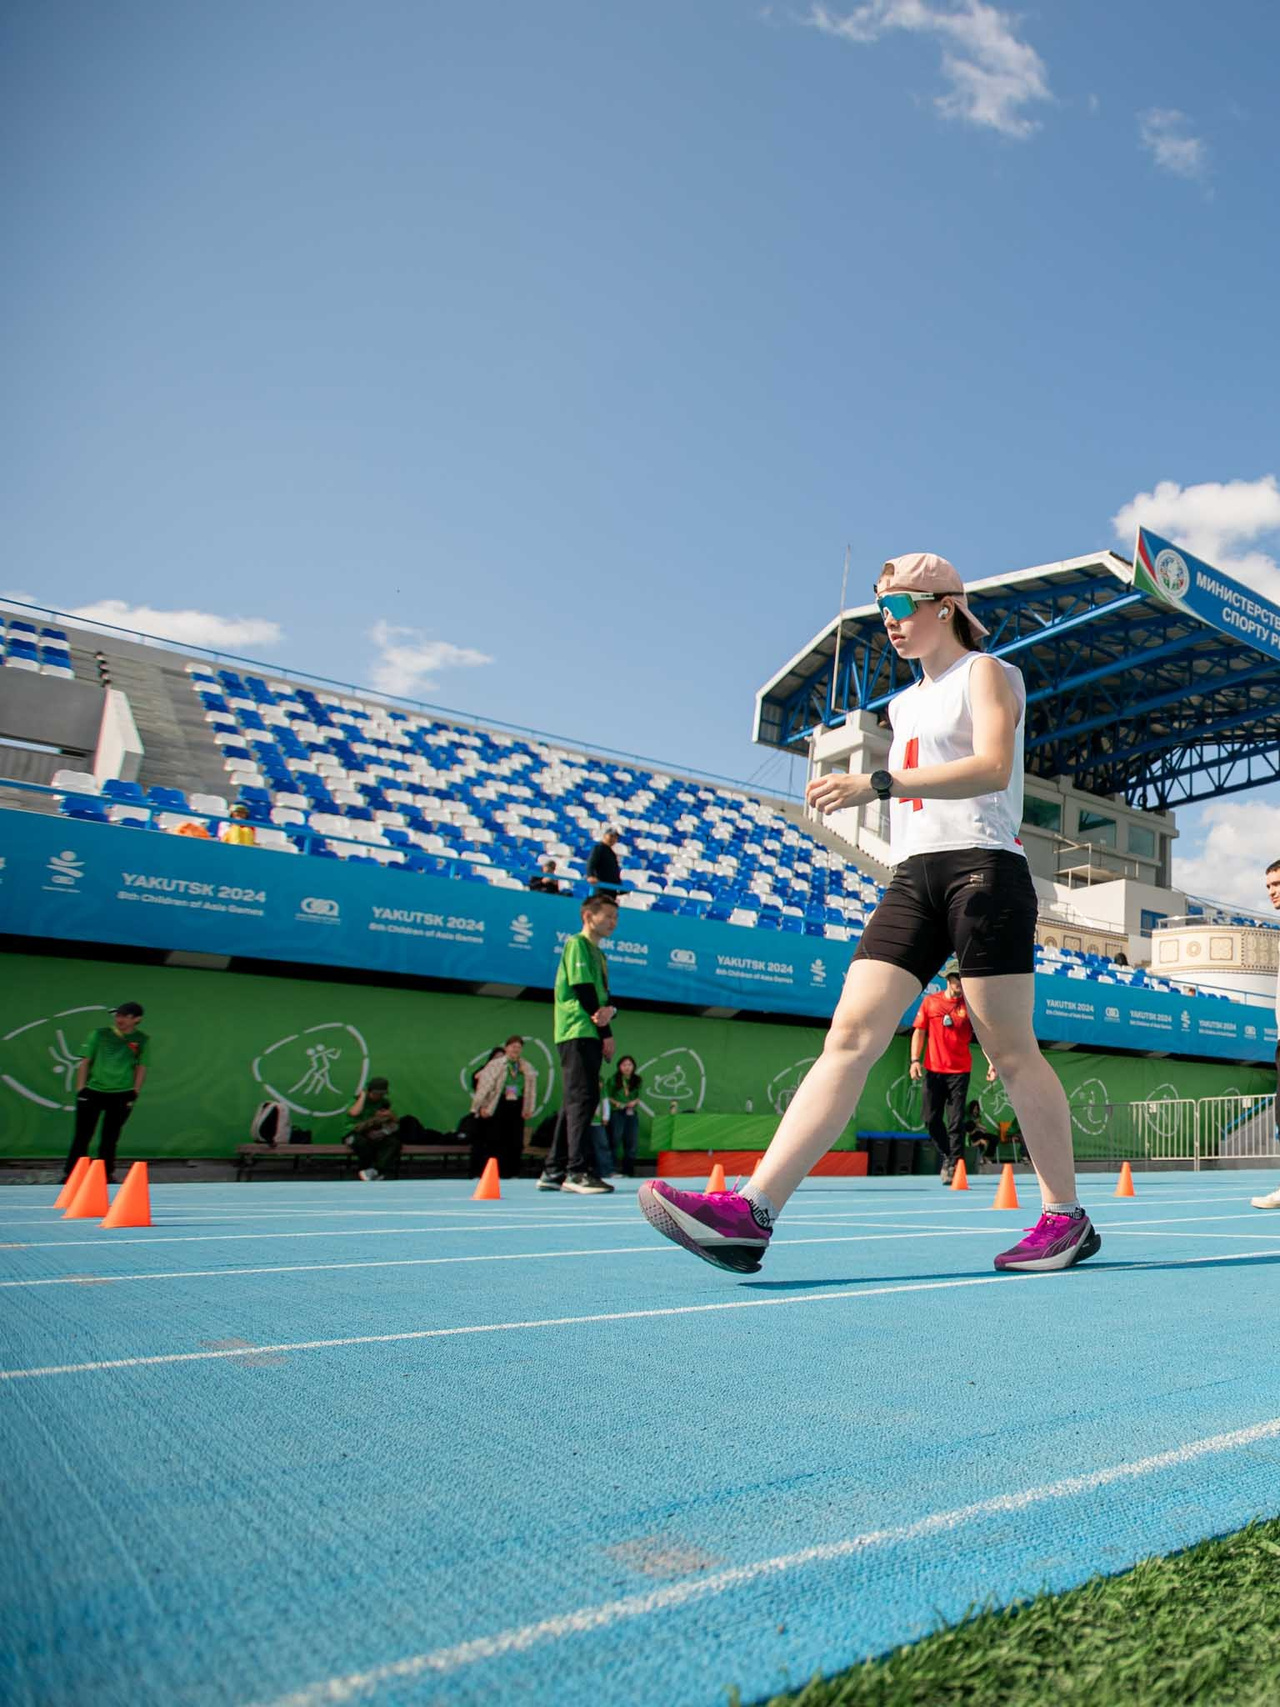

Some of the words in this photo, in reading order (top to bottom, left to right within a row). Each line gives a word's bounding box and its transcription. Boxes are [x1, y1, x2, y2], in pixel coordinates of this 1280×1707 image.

[1222, 606, 1269, 642] СПОРТУ
[121, 872, 215, 897] YAKUTSK
[217, 886, 266, 903] 2024
[141, 893, 189, 907] Children
[190, 900, 202, 909] of
[228, 904, 264, 917] Games
[371, 906, 444, 927] YAKUTSK
[446, 916, 485, 932] 2024
[616, 940, 648, 955] 2024
[717, 955, 765, 971] YAKUTSK
[767, 961, 794, 975] 2024
[1046, 999, 1077, 1011] YAKUTSK
[1077, 1003, 1095, 1013] 2024
